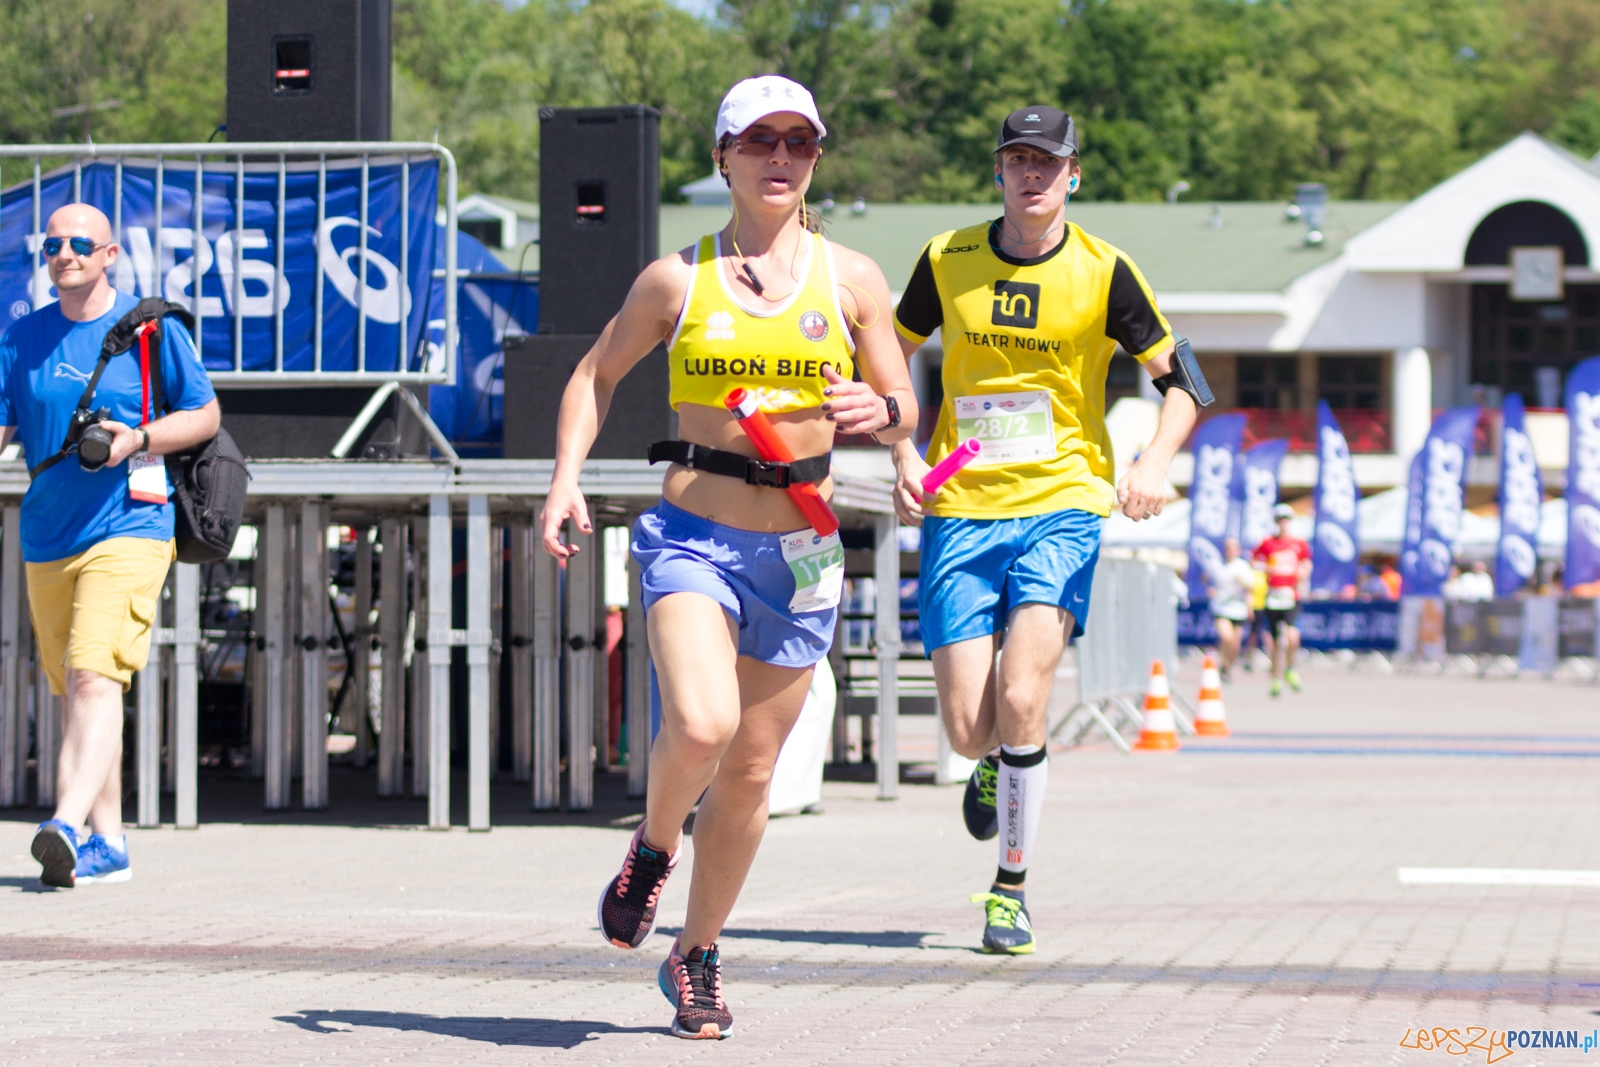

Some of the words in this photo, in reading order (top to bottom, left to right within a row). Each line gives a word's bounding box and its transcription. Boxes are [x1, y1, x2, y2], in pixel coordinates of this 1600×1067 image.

[965, 332, 1009, 347] TEATR
[1015, 336, 1061, 353] NOWY
[685, 355, 766, 376] LUBOŃ
[974, 415, 1030, 440] 28/2
